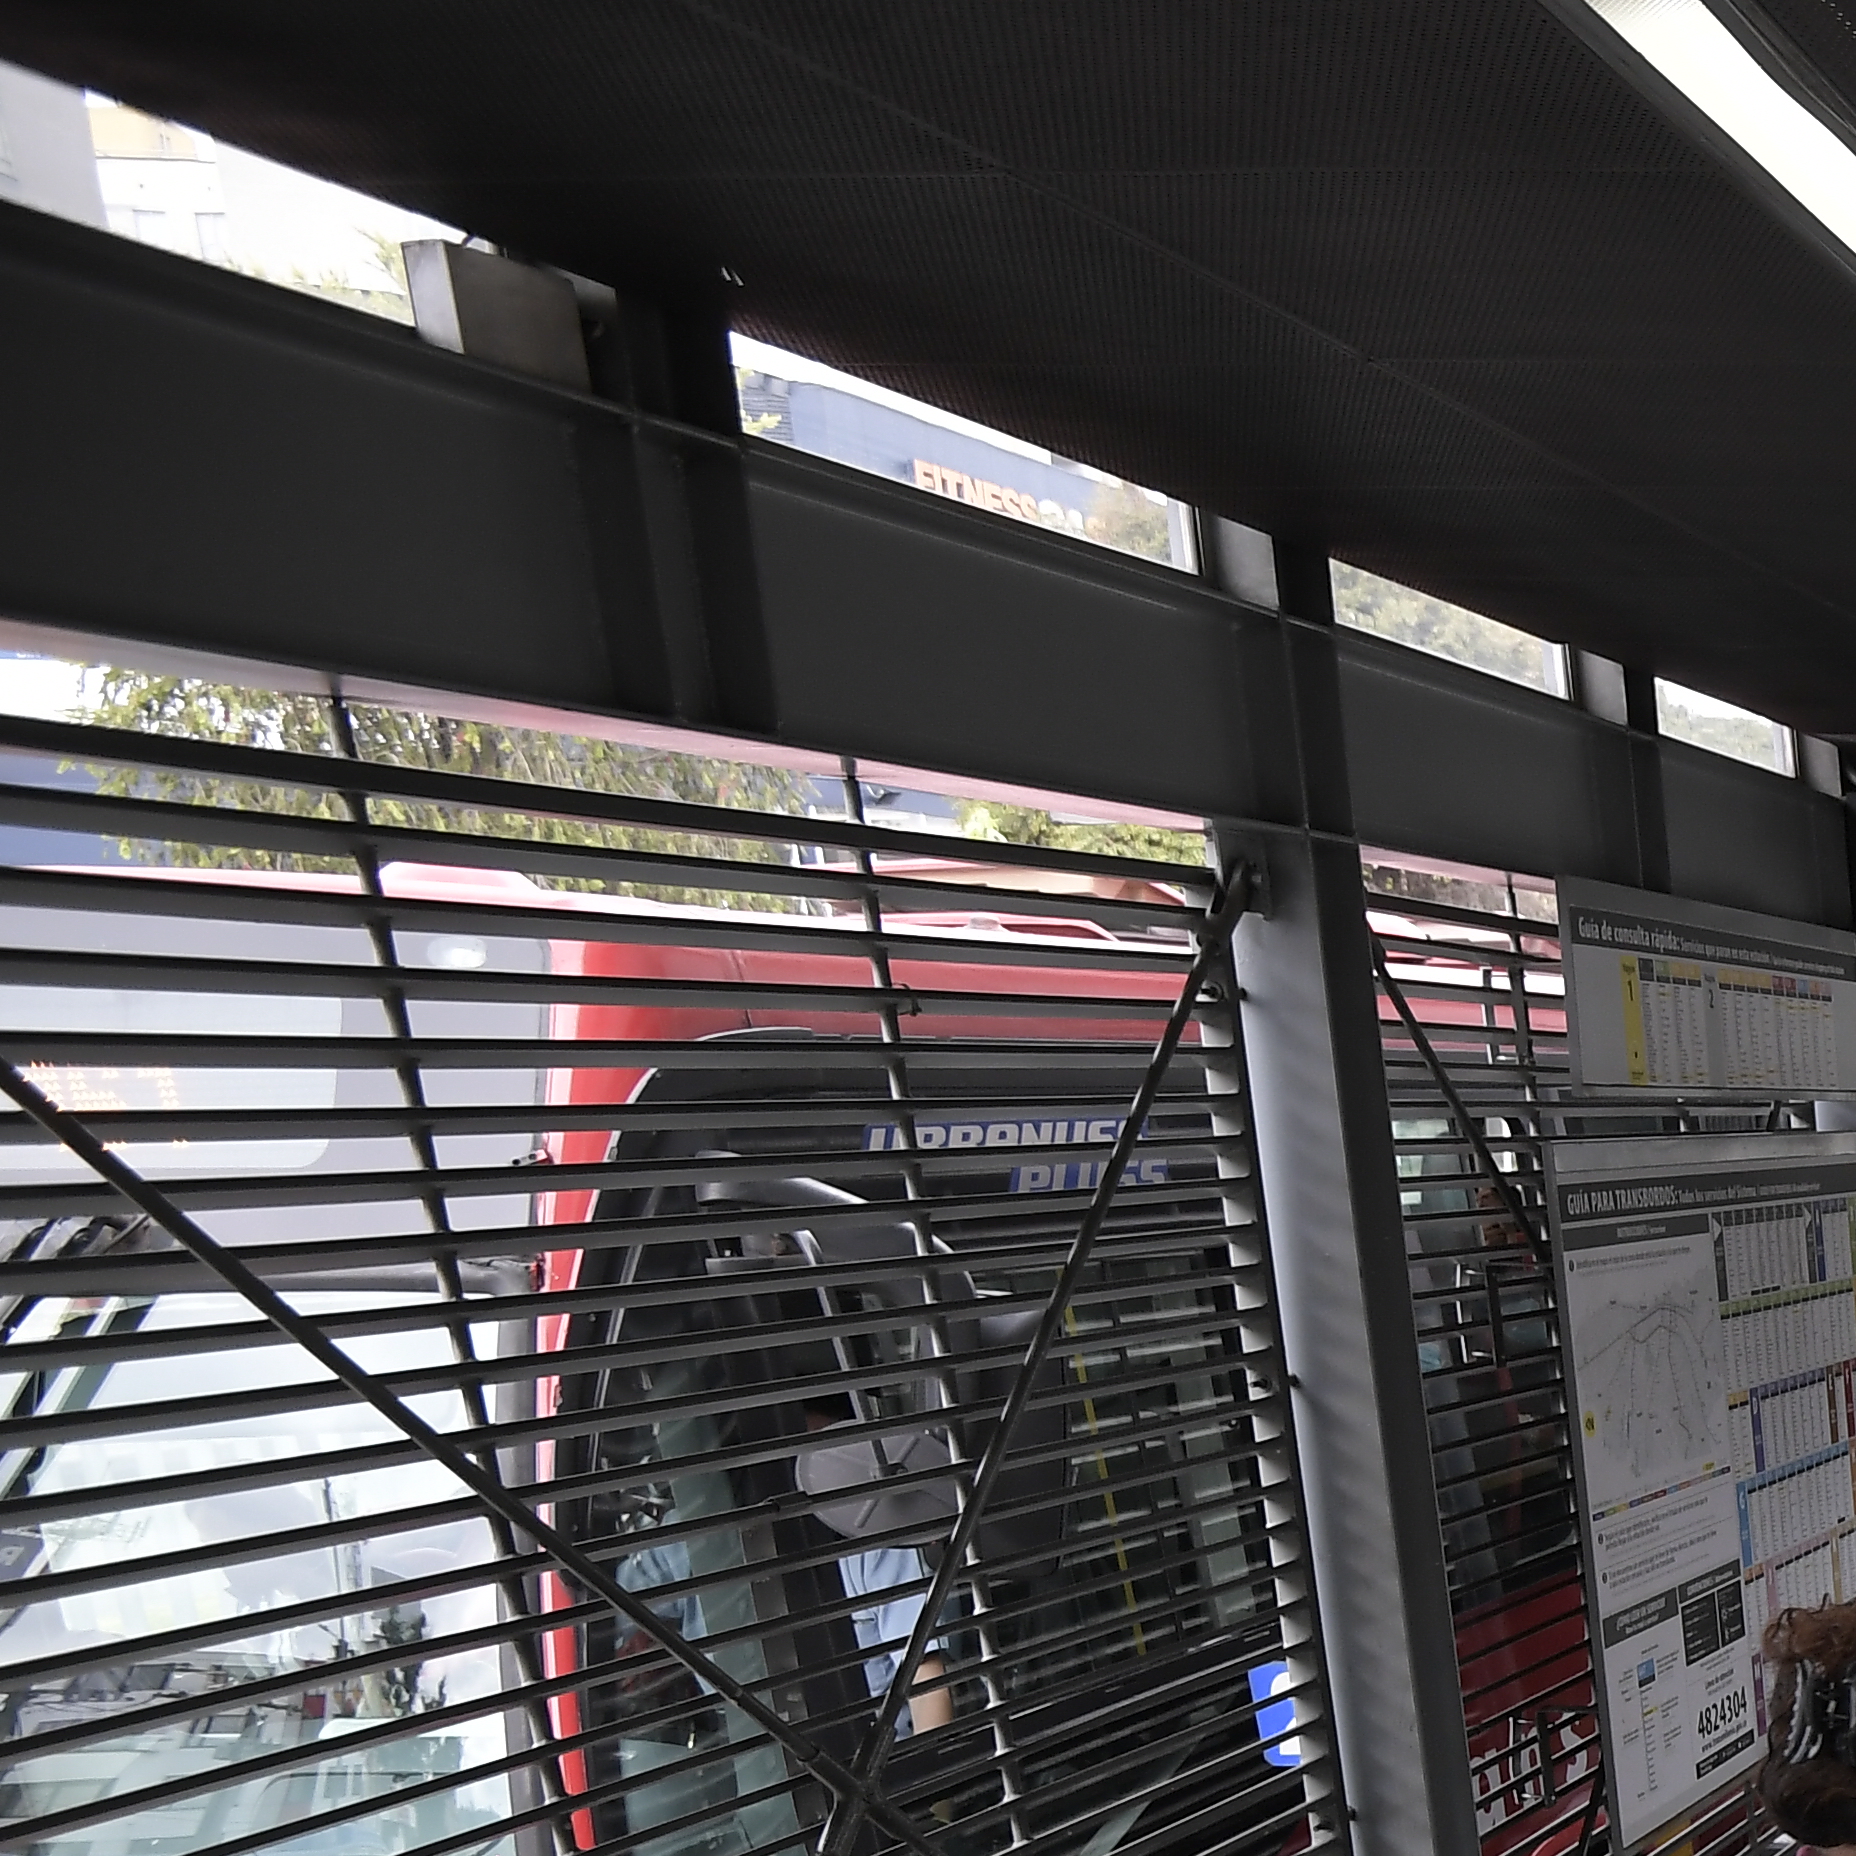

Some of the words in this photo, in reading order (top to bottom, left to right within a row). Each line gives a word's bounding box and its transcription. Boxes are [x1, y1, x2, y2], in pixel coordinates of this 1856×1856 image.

[914, 458, 1038, 521] FITNESS
[1591, 1189, 1615, 1215] PARA
[1697, 1685, 1749, 1740] 4824304
